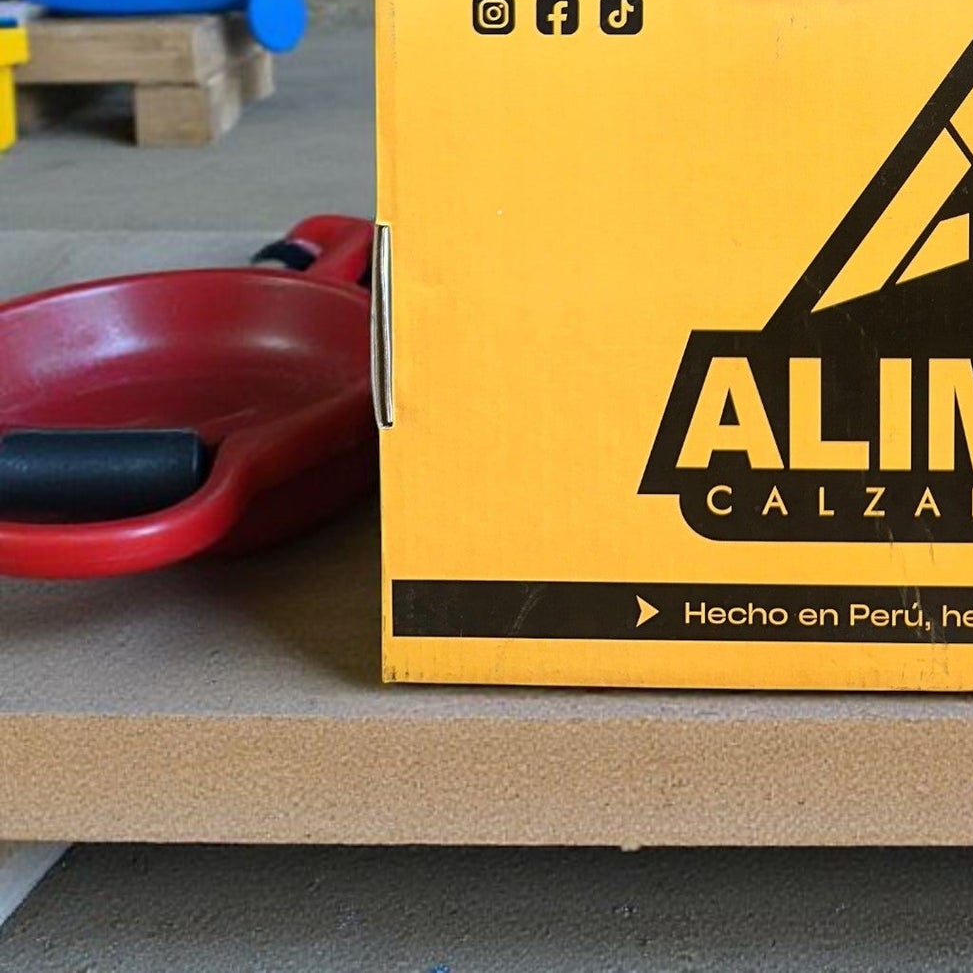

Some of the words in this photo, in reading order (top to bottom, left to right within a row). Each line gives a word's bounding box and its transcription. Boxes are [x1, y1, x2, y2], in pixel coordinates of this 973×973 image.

[684, 601, 789, 626] Hecho
[798, 608, 839, 626] en
[849, 601, 931, 632] Perú,
